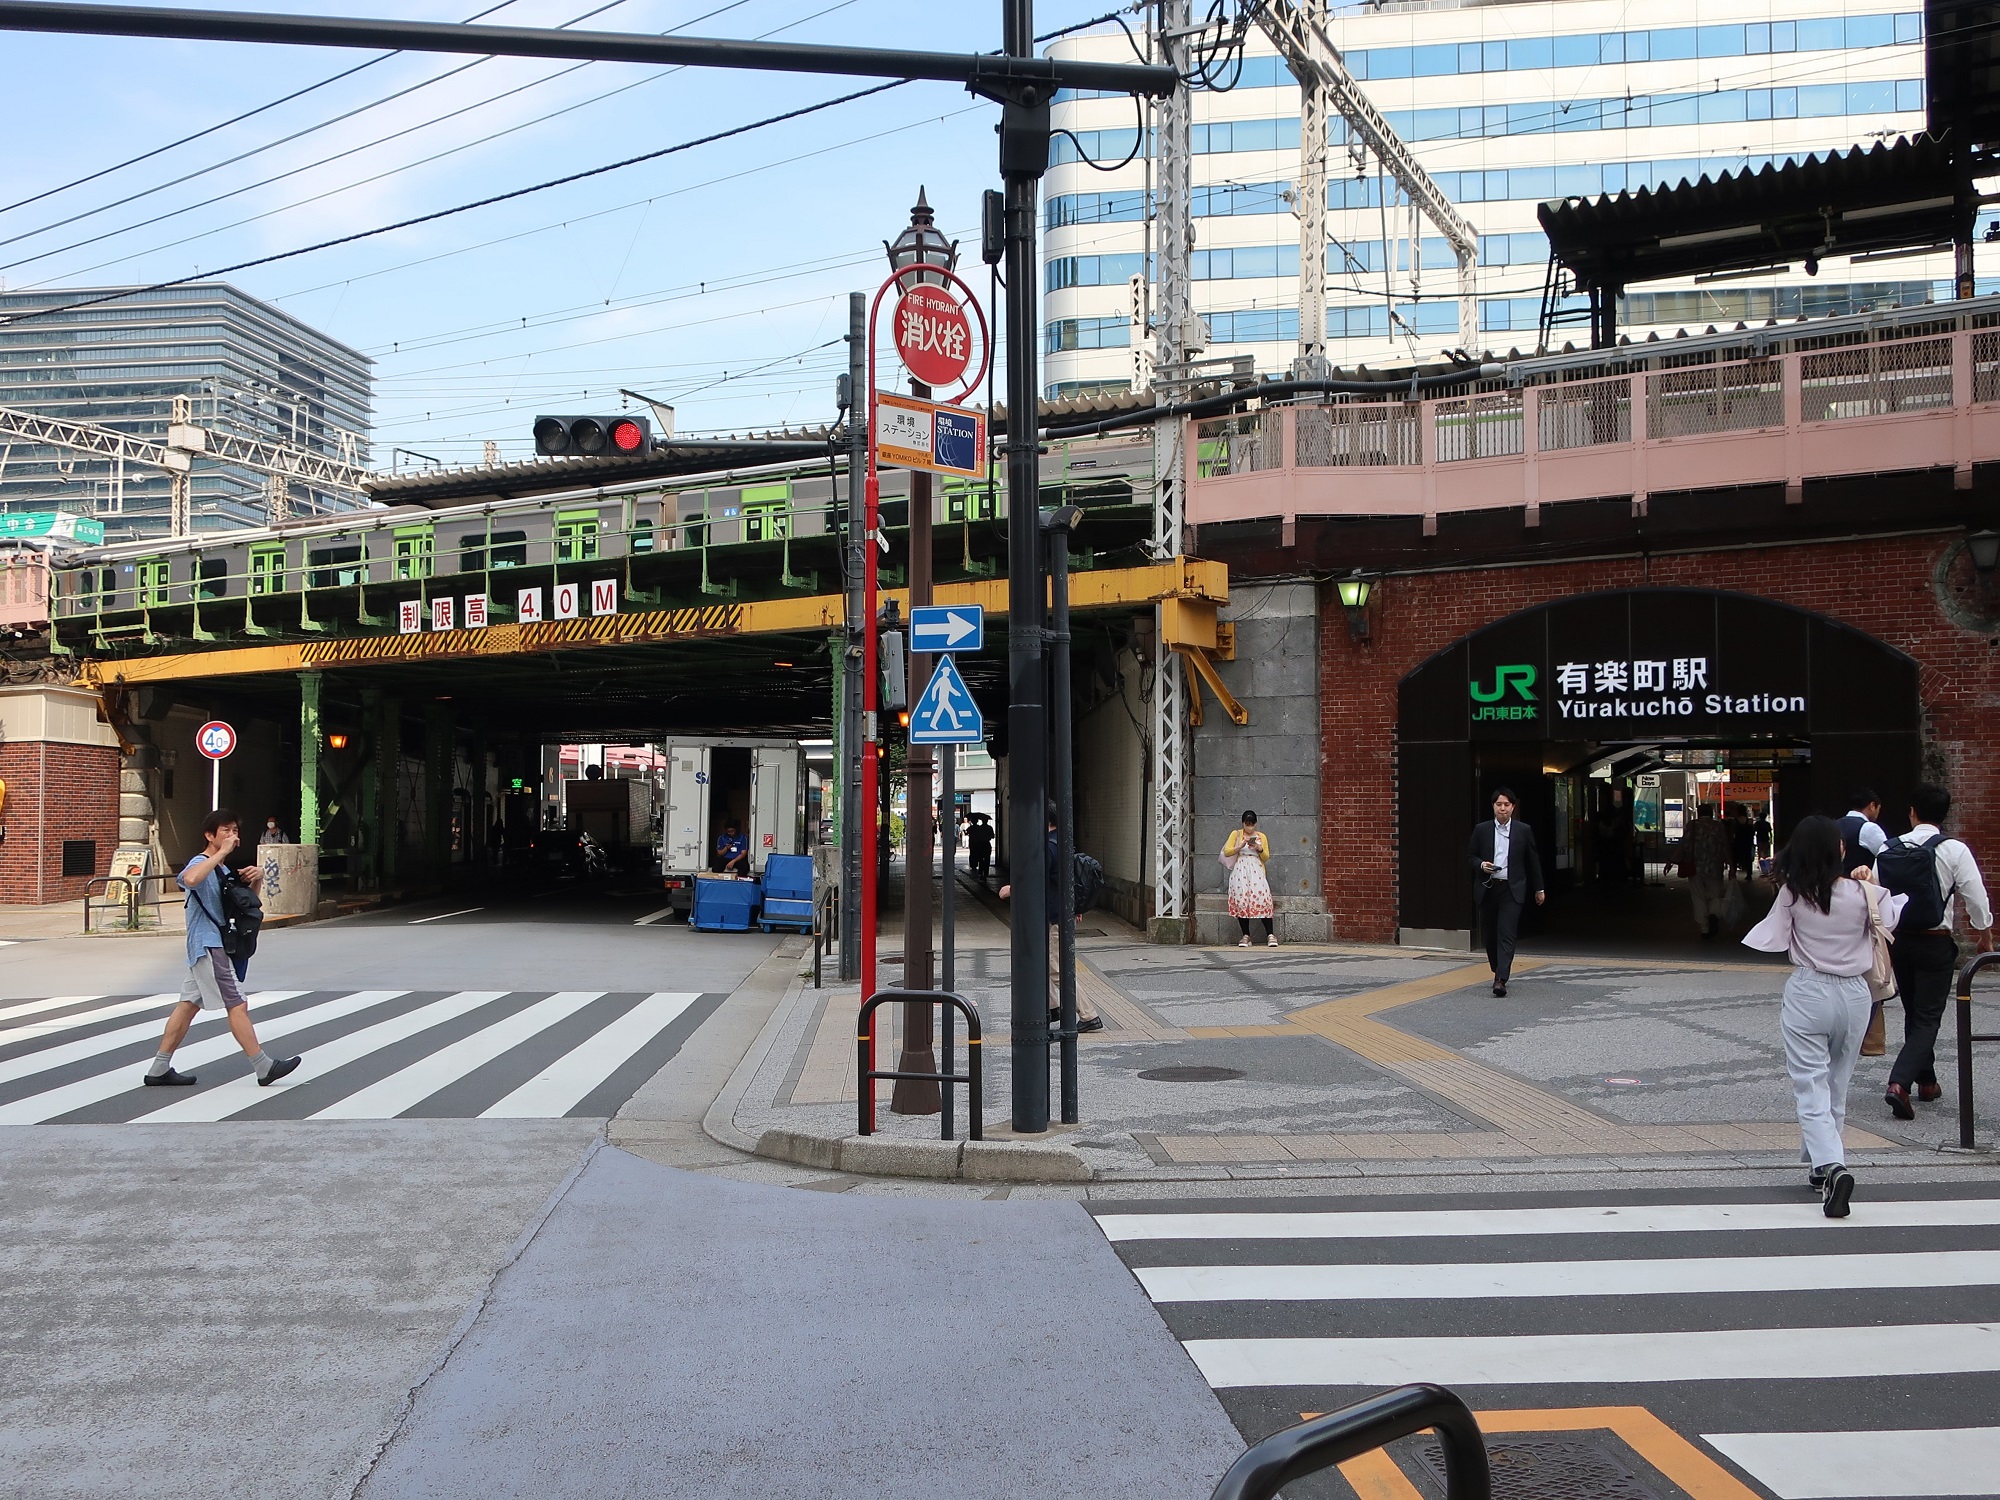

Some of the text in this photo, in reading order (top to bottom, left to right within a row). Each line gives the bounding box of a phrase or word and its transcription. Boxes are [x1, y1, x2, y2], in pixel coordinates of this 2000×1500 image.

[907, 293, 960, 316] FIRE HYDRANT
[901, 309, 967, 361] 消火栓
[882, 423, 930, 441] ステーション
[897, 414, 915, 428] 環境
[936, 425, 974, 440] STATION
[1470, 664, 1536, 702] JR
[1556, 657, 1708, 695] 有楽町駅
[1472, 705, 1537, 721] JR東日本
[1556, 693, 1806, 719] Yūrakuchō Station
